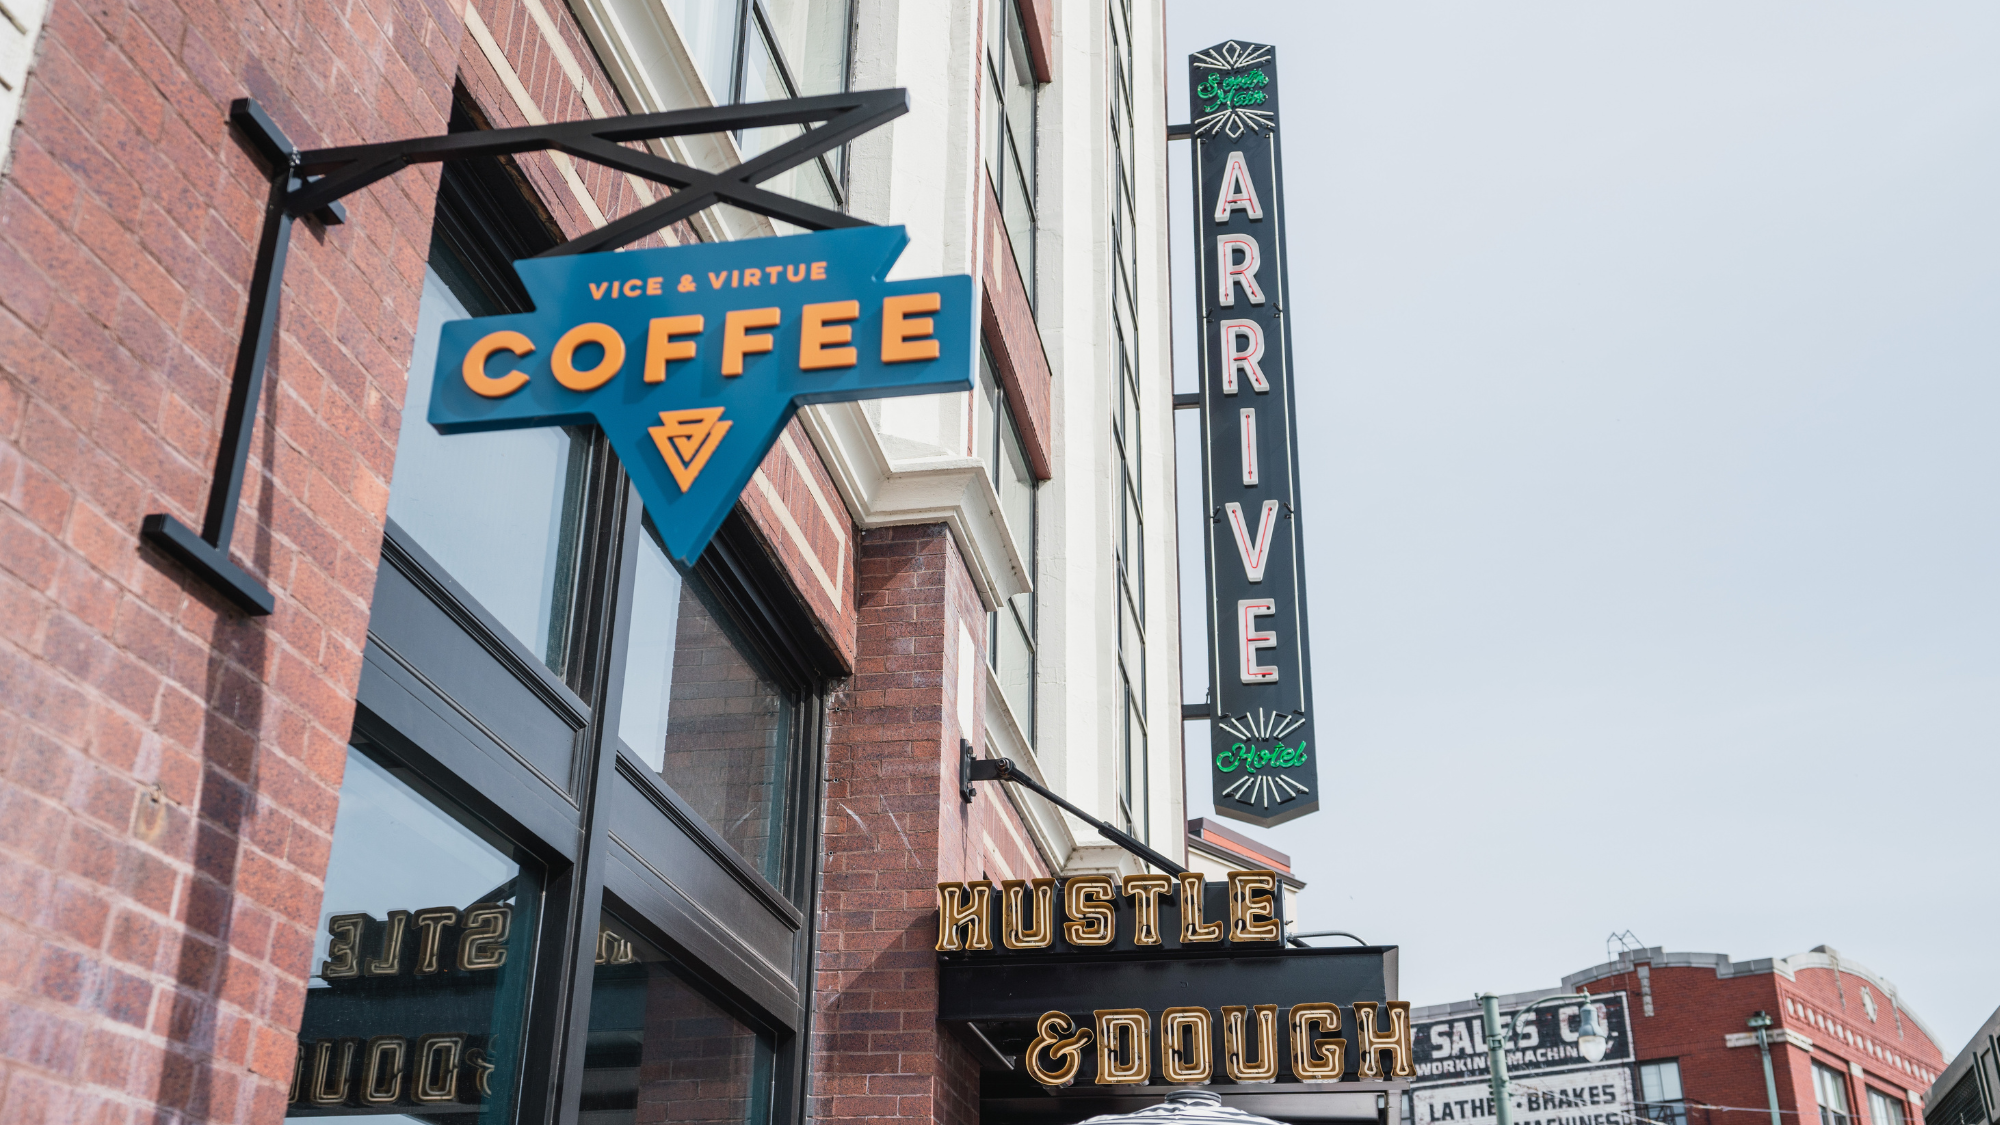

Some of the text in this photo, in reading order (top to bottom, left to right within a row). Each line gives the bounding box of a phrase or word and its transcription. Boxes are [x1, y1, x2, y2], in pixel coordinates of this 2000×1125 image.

[1197, 68, 1269, 98] South
[1203, 87, 1268, 112] Main
[588, 261, 828, 300] VICE & VIRTUE
[462, 292, 941, 397] COFFEE
[1214, 151, 1280, 683] ARRIVE
[1216, 740, 1308, 774] Hotel
[935, 870, 1281, 951] HUSTLE
[1430, 1011, 1540, 1059] SALES
[1415, 1040, 1614, 1077] WORKIN MACHINY
[1527, 1084, 1616, 1112] BRAKES
